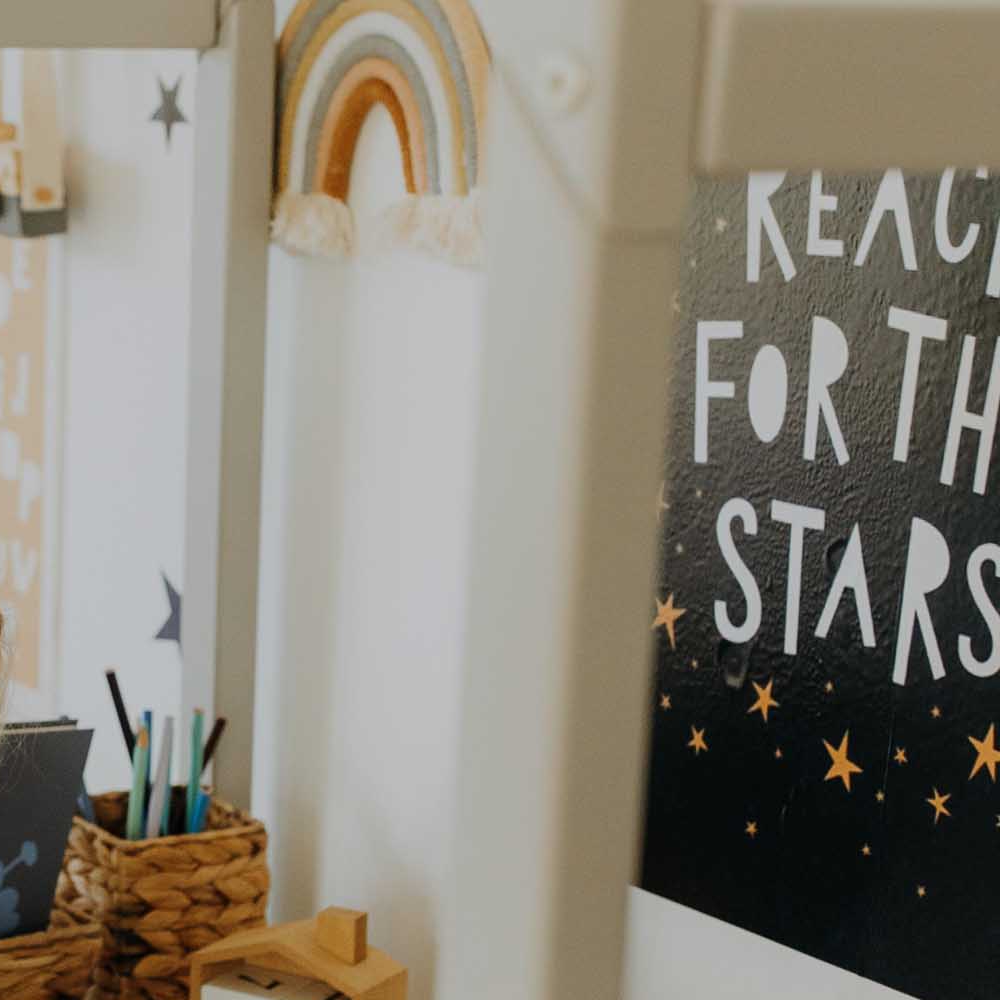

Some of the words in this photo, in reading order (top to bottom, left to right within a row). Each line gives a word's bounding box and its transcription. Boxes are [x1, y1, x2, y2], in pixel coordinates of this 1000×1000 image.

[747, 167, 1000, 297] REAC
[695, 316, 849, 465] FOR
[715, 499, 1000, 684] STARS
